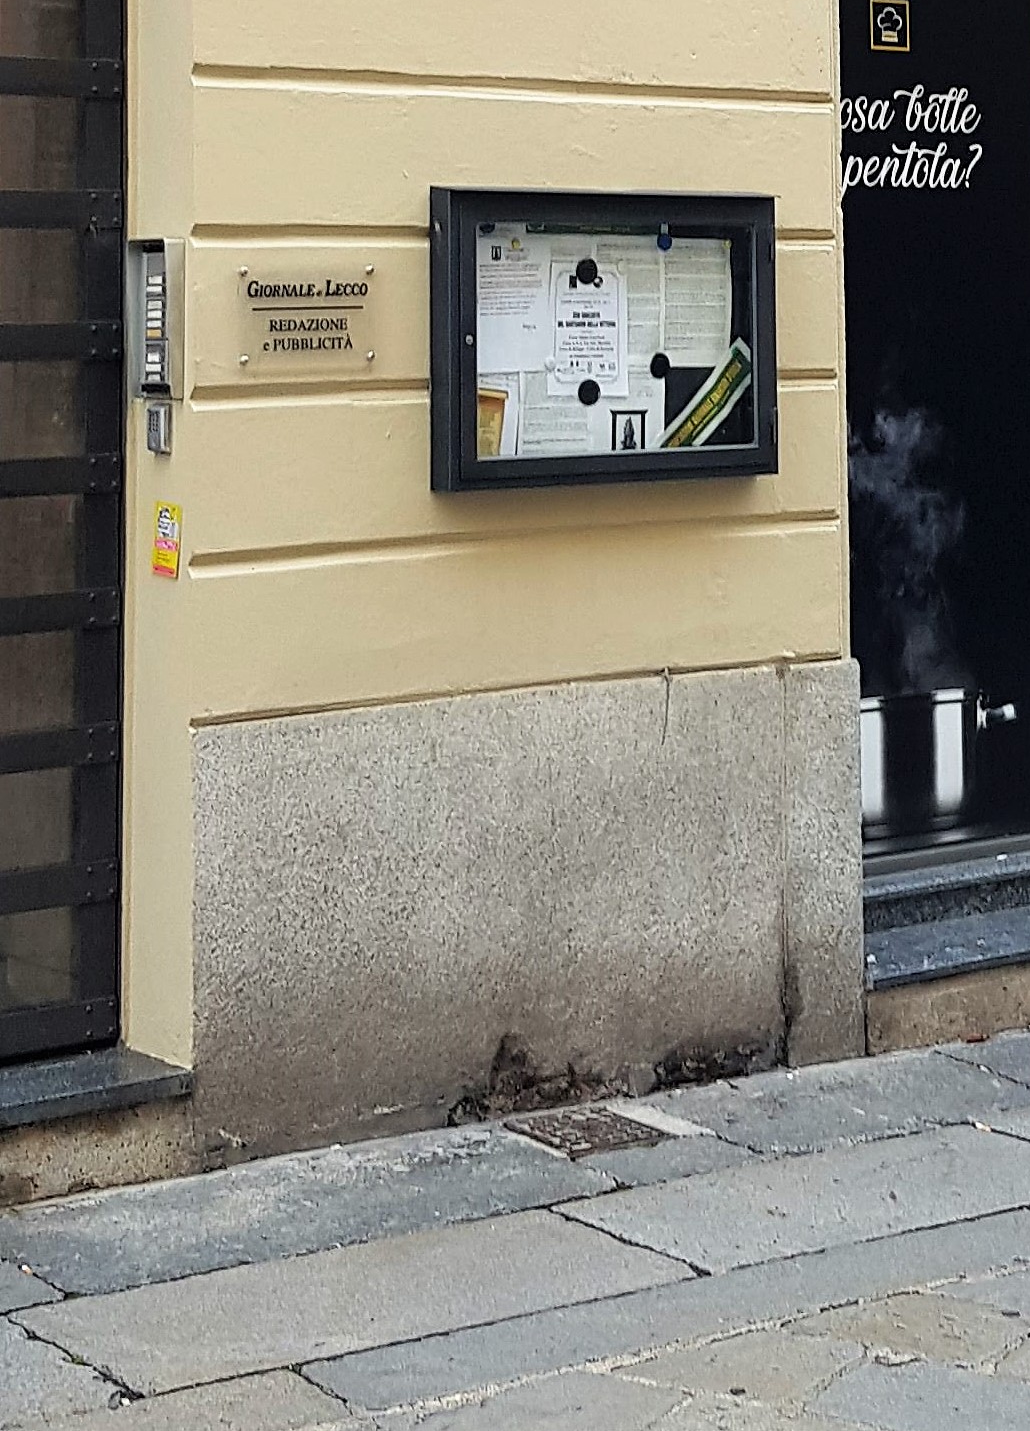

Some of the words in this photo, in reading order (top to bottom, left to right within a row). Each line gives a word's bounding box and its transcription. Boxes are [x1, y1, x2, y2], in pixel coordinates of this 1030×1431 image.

[893, 84, 982, 134] bolle
[840, 141, 983, 197] pentola?
[269, 318, 348, 333] REDAZIONE
[273, 332, 353, 351] PUBBLICITÀ
